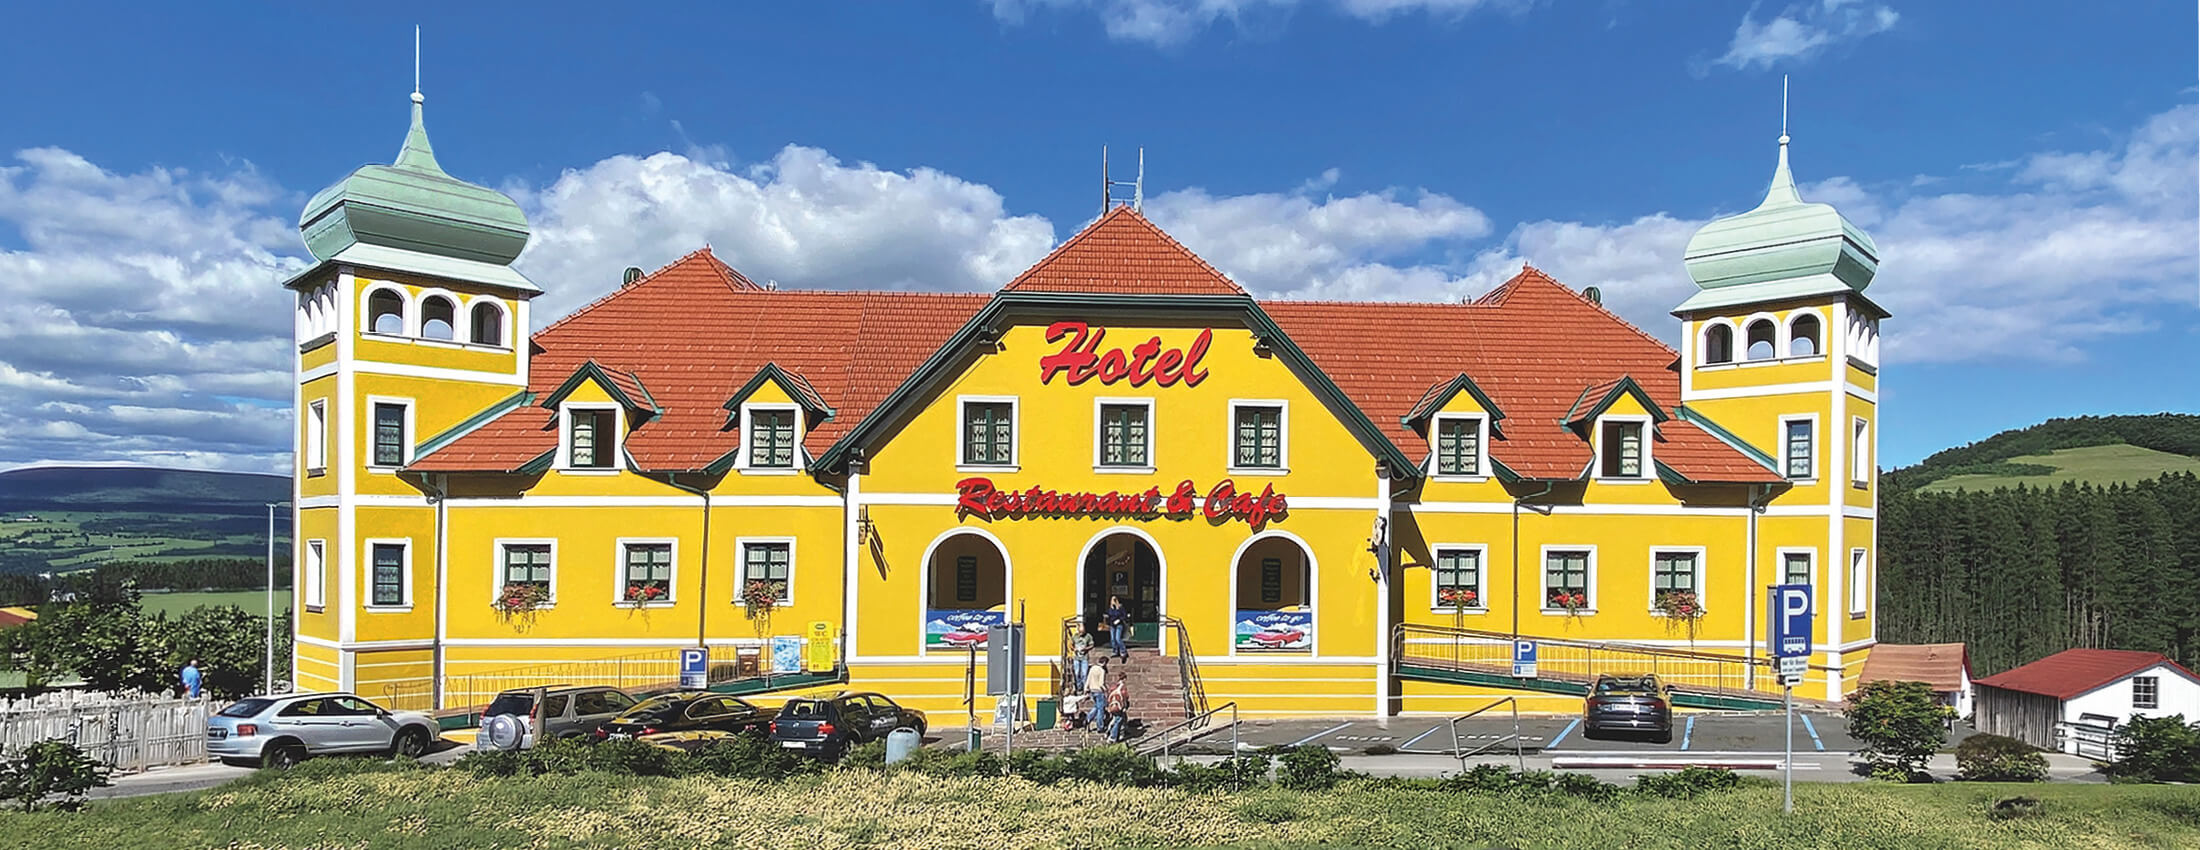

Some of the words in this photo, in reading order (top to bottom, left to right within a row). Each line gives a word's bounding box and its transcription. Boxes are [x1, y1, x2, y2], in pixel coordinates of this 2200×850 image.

[1040, 321, 1212, 386] Hotel
[955, 477, 1160, 516] Restaurant
[1166, 480, 1194, 515] &
[1203, 478, 1286, 529] Cafe
[947, 612, 973, 622] coffee
[973, 613, 983, 621] to
[981, 614, 997, 623] go
[1256, 613, 1281, 622] coffee
[1289, 615, 1304, 624] go
[1783, 589, 1809, 635] P
[1517, 641, 1533, 660] P
[685, 651, 702, 671] P
